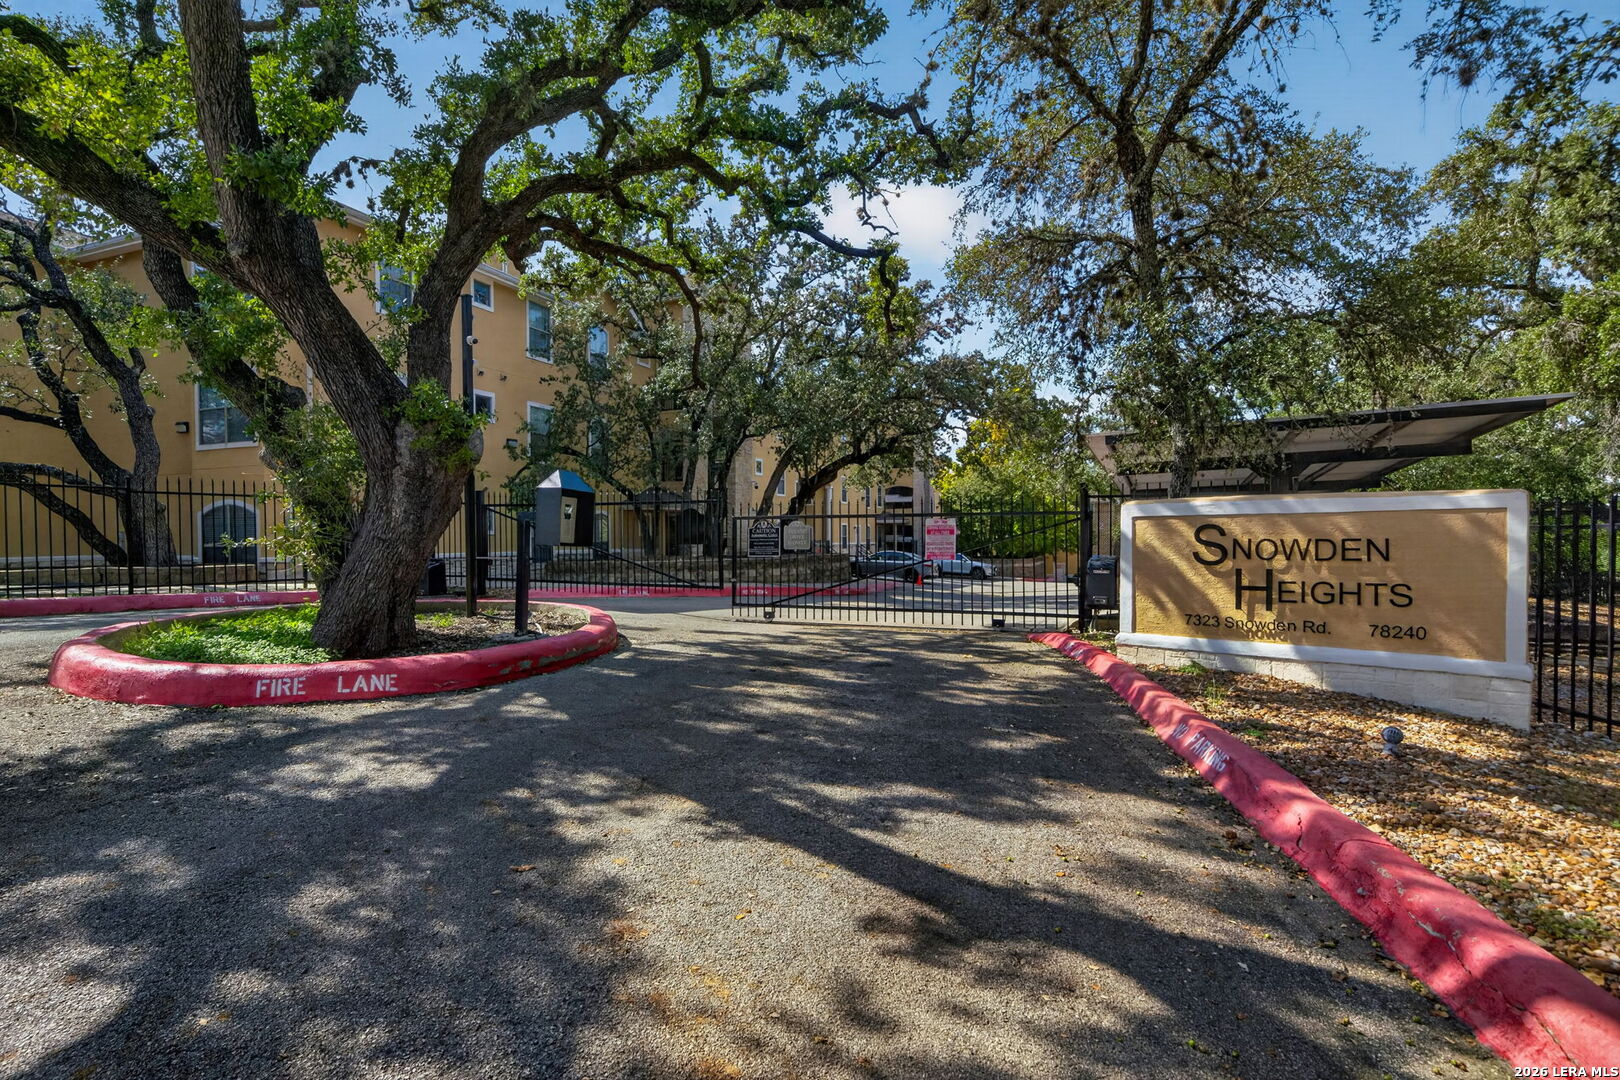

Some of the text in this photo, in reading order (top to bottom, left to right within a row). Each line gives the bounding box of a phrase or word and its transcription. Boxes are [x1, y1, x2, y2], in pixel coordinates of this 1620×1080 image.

[1193, 523, 1390, 566] SNOWDEN
[203, 594, 261, 604] FIRE LANE
[1235, 569, 1413, 612] HEIGHTS
[1184, 614, 1427, 640] 7323 Snowden Rd. 78240
[255, 674, 399, 698] FIRE LANE
[1172, 723, 1230, 772] NO PARKING
